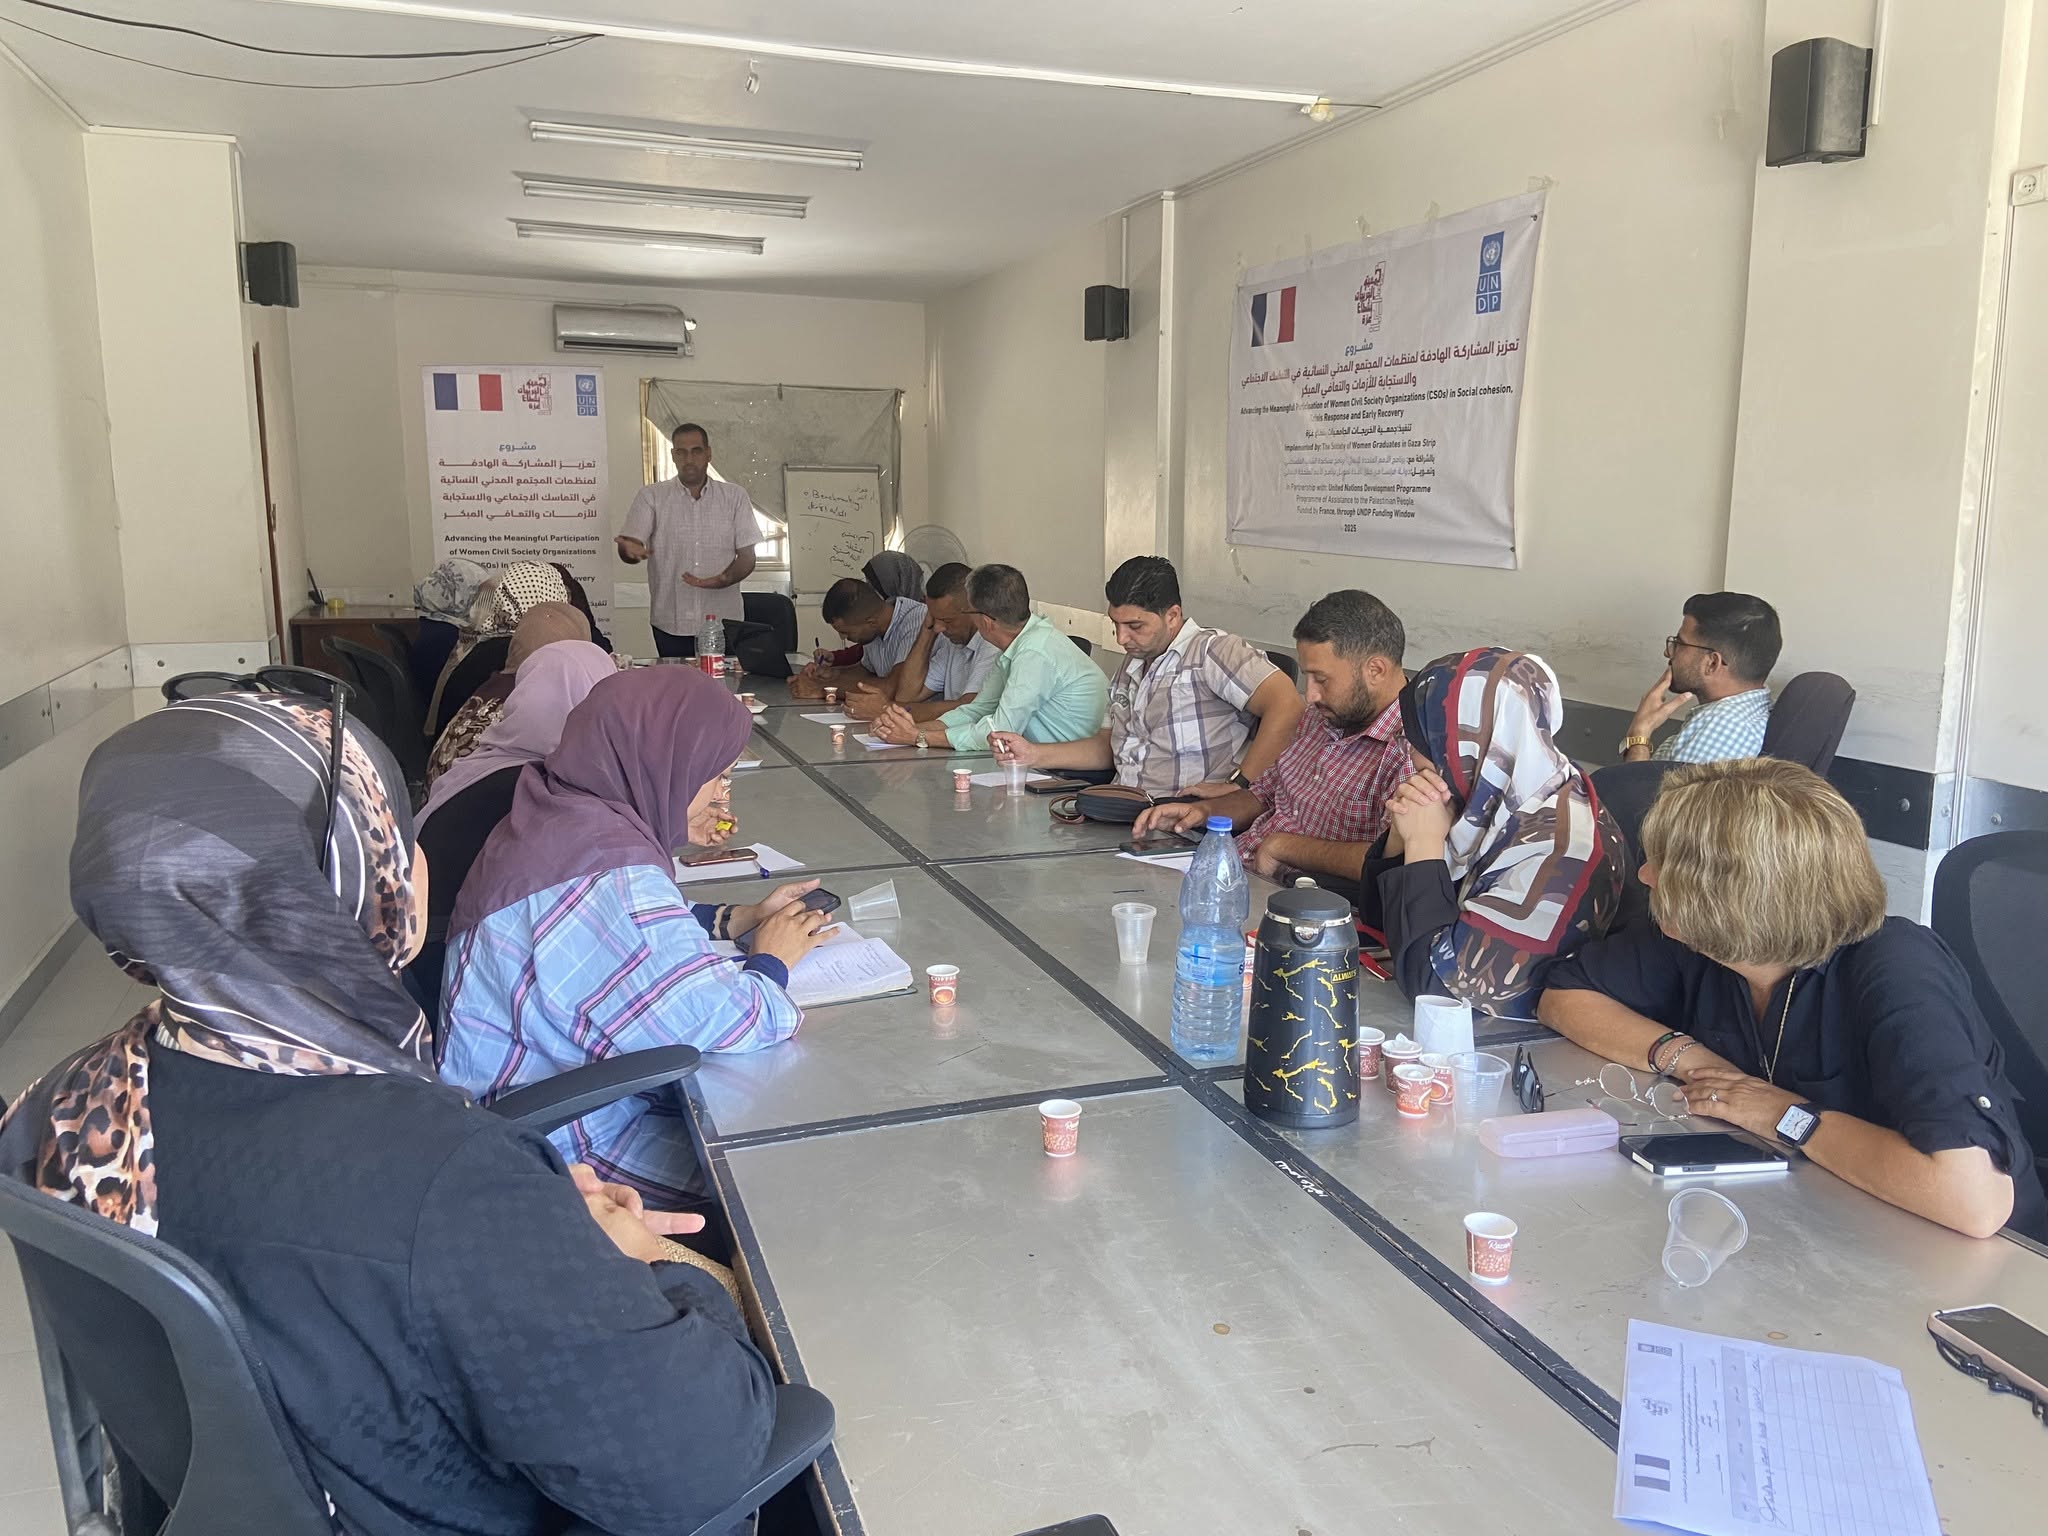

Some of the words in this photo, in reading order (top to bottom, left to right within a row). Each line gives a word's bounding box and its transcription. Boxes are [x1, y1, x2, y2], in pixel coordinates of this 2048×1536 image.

[1345, 338, 1373, 356] مشروع
[1454, 341, 1494, 359] المشاركة
[1496, 339, 1519, 356] تعزيز
[1384, 352, 1418, 368] لمنظمات
[1420, 347, 1450, 363] الهادفة
[1330, 361, 1353, 379] المدني
[1355, 357, 1382, 374] المجتمع
[1291, 368, 1301, 384] في
[1302, 364, 1329, 380] النسائية
[1352, 375, 1376, 391] للأزمات
[1379, 372, 1416, 389] والاستجابة
[1301, 383, 1320, 398] المبكر
[1321, 380, 1349, 398] والتعافي
[1330, 399, 1350, 408] Women
[1351, 398, 1362, 406] Civil
[1364, 396, 1384, 405] Society
[1385, 391, 1425, 404] Organizations
[1427, 389, 1448, 400] (CSOs)
[1449, 389, 1456, 398] in
[1457, 386, 1478, 397] Social
[1479, 384, 1513, 396] cohesion,
[1324, 412, 1349, 421] Response
[1350, 411, 1361, 420] and
[1362, 409, 1376, 420] Early
[1378, 408, 1404, 418] Recovery
[499, 442, 536, 452] مشروع
[1352, 441, 1371, 449] Women
[1372, 440, 1400, 449] Graduates
[1408, 439, 1421, 447] Gaza
[1422, 438, 1436, 448] Strip
[438, 458, 499, 469] الهادفة
[501, 458, 557, 470] المشاركة
[559, 460, 596, 469] تعزيز
[440, 476, 478, 487] النسائية
[481, 476, 513, 488] المدني
[516, 476, 552, 486] المجتمع
[555, 476, 596, 485] لمنظمات
[1328, 483, 1343, 491] United
[1344, 483, 1363, 492] Nations
[1364, 484, 1395, 493] Development
[1396, 484, 1431, 494] Programme
[442, 493, 491, 503] والاستجابة
[494, 493, 539, 504] الاجتماعي
[542, 493, 579, 502] التماسك
[582, 494, 596, 505] في
[443, 510, 483, 520] المبكر
[486, 509, 540, 521] والتعافي
[543, 509, 597, 519] للأزمات
[1337, 507, 1355, 517] through
[1357, 508, 1371, 516] UNDP
[1372, 508, 1393, 519] Funding
[1394, 509, 1415, 518] Window
[1344, 524, 1357, 532] 2025
[445, 535, 487, 544] Advancing
[504, 535, 548, 544] Meaningful
[550, 535, 600, 543] Participation
[511, 548, 540, 557] Society
[542, 548, 596, 557] Organizations
